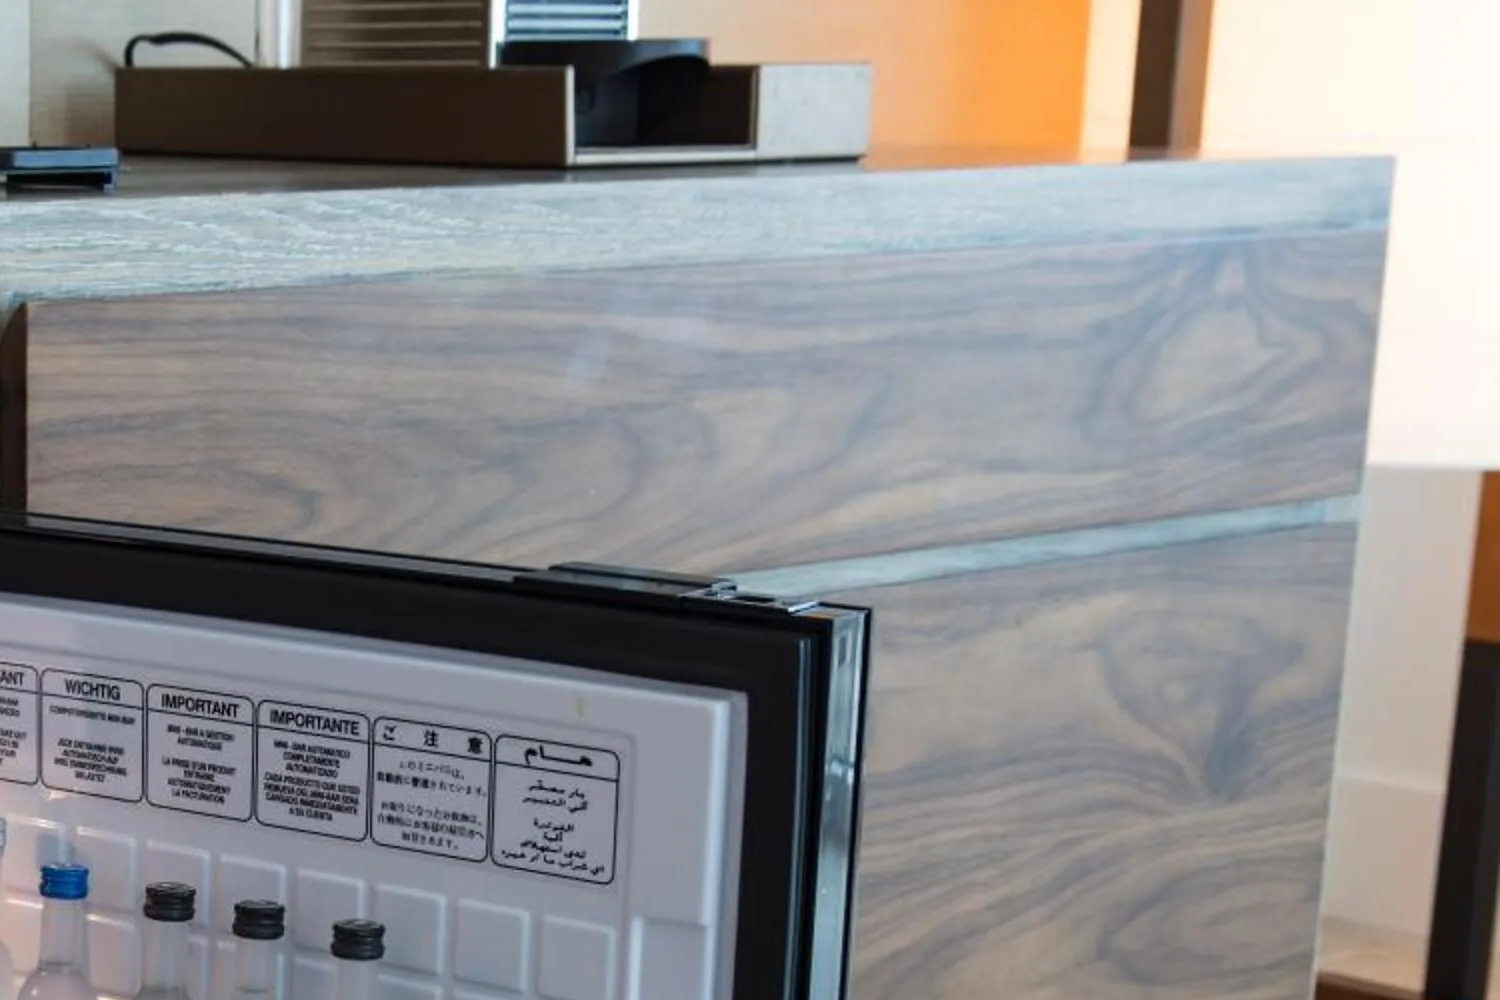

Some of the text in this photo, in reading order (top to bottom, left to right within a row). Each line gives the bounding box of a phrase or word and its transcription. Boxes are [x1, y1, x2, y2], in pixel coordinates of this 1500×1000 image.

[64, 679, 121, 701] WICHTIG
[161, 693, 240, 718] IMPORTANT
[270, 709, 360, 735] IMPORTANTE
